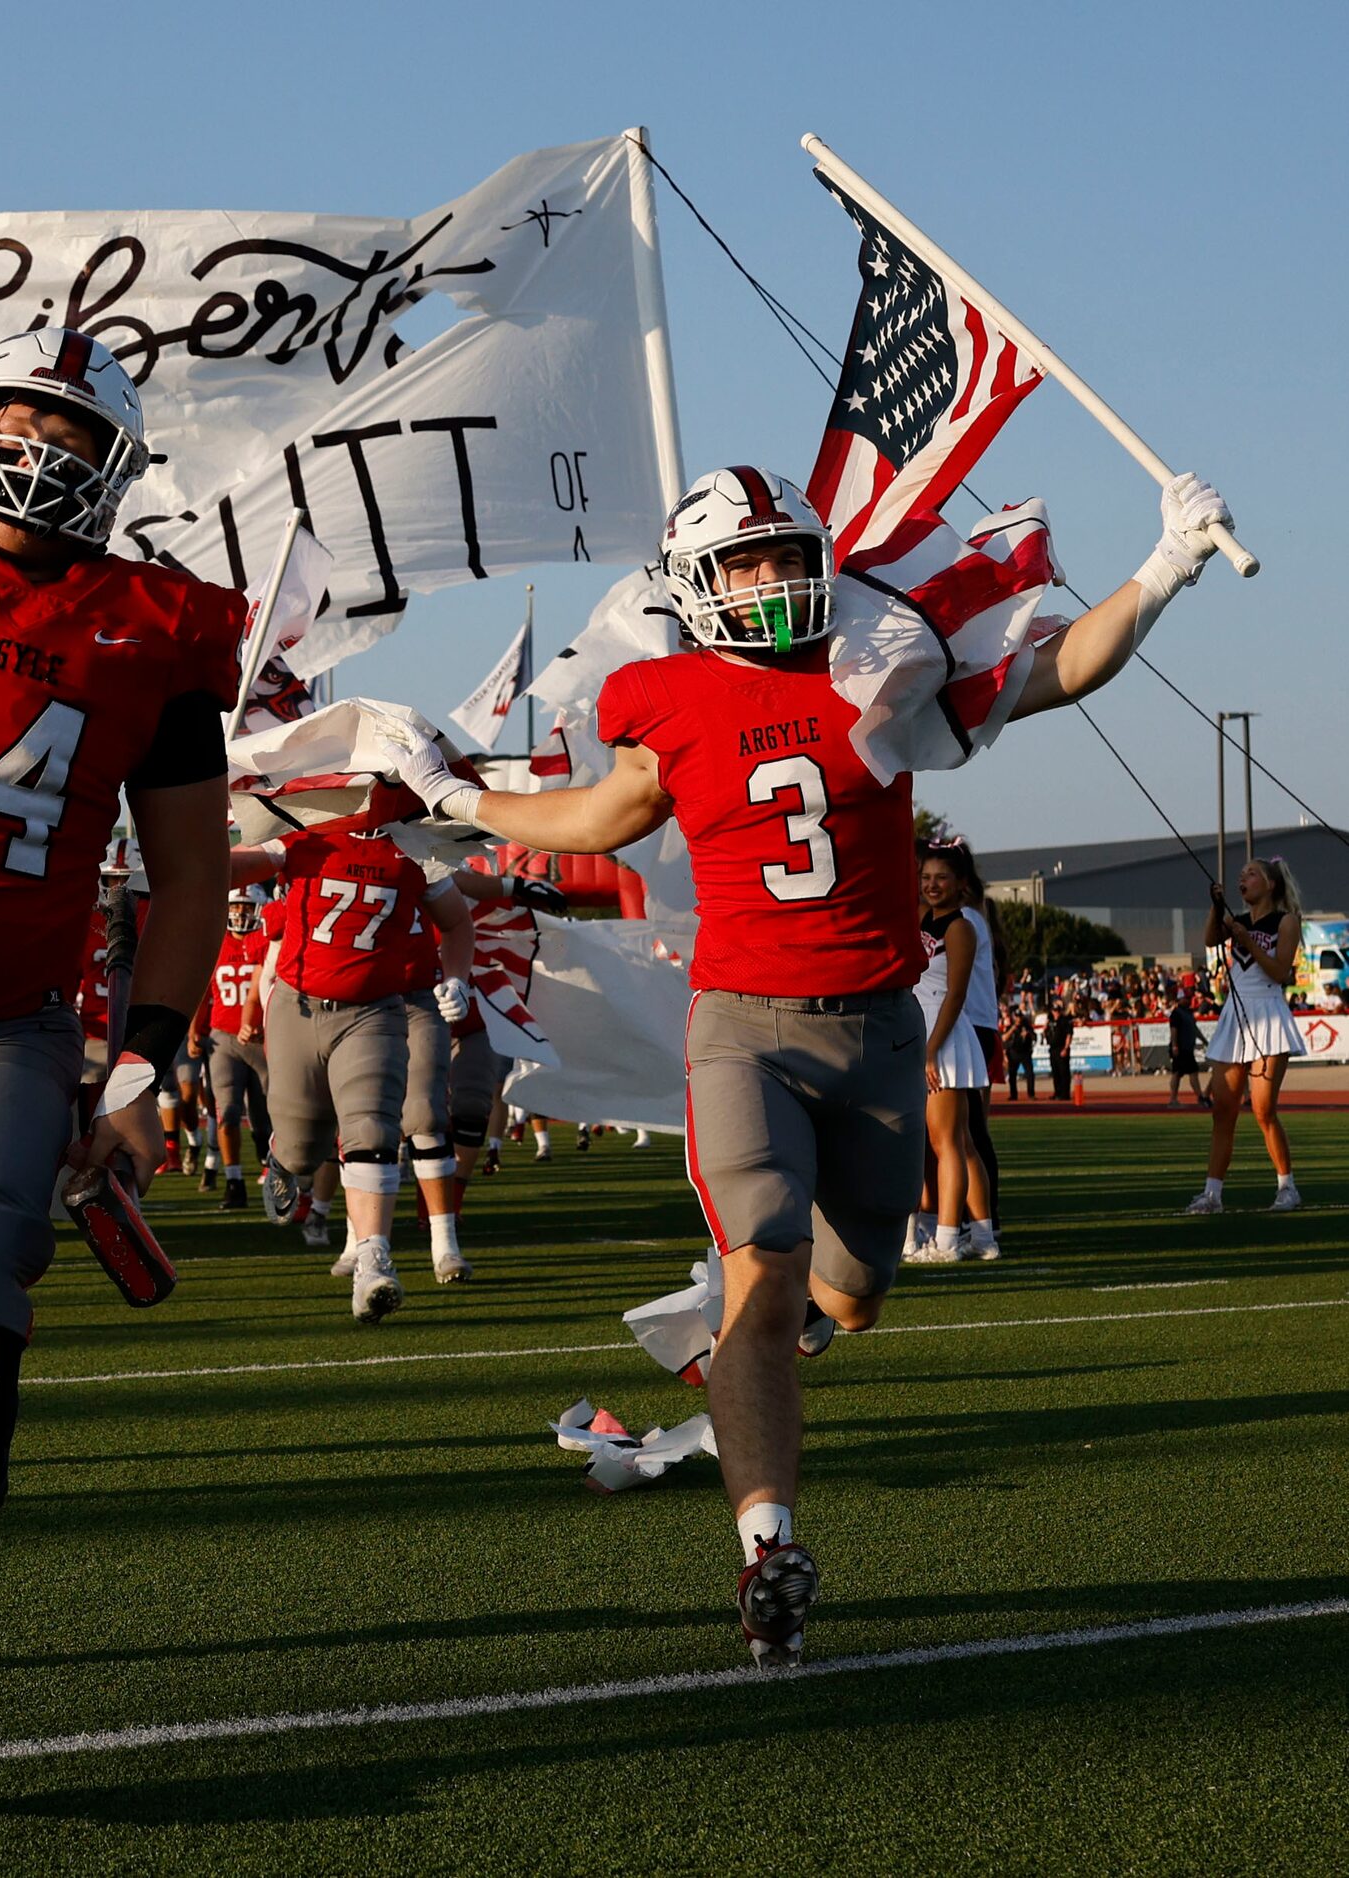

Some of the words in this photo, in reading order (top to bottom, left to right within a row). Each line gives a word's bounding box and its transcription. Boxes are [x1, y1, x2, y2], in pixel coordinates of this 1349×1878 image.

[551, 451, 589, 513] OF
[738, 716, 821, 757] ARGYLE
[747, 753, 837, 902] 3
[346, 862, 386, 881] ARGYLE
[311, 876, 398, 951] 77
[49, 990, 61, 1003] XL
